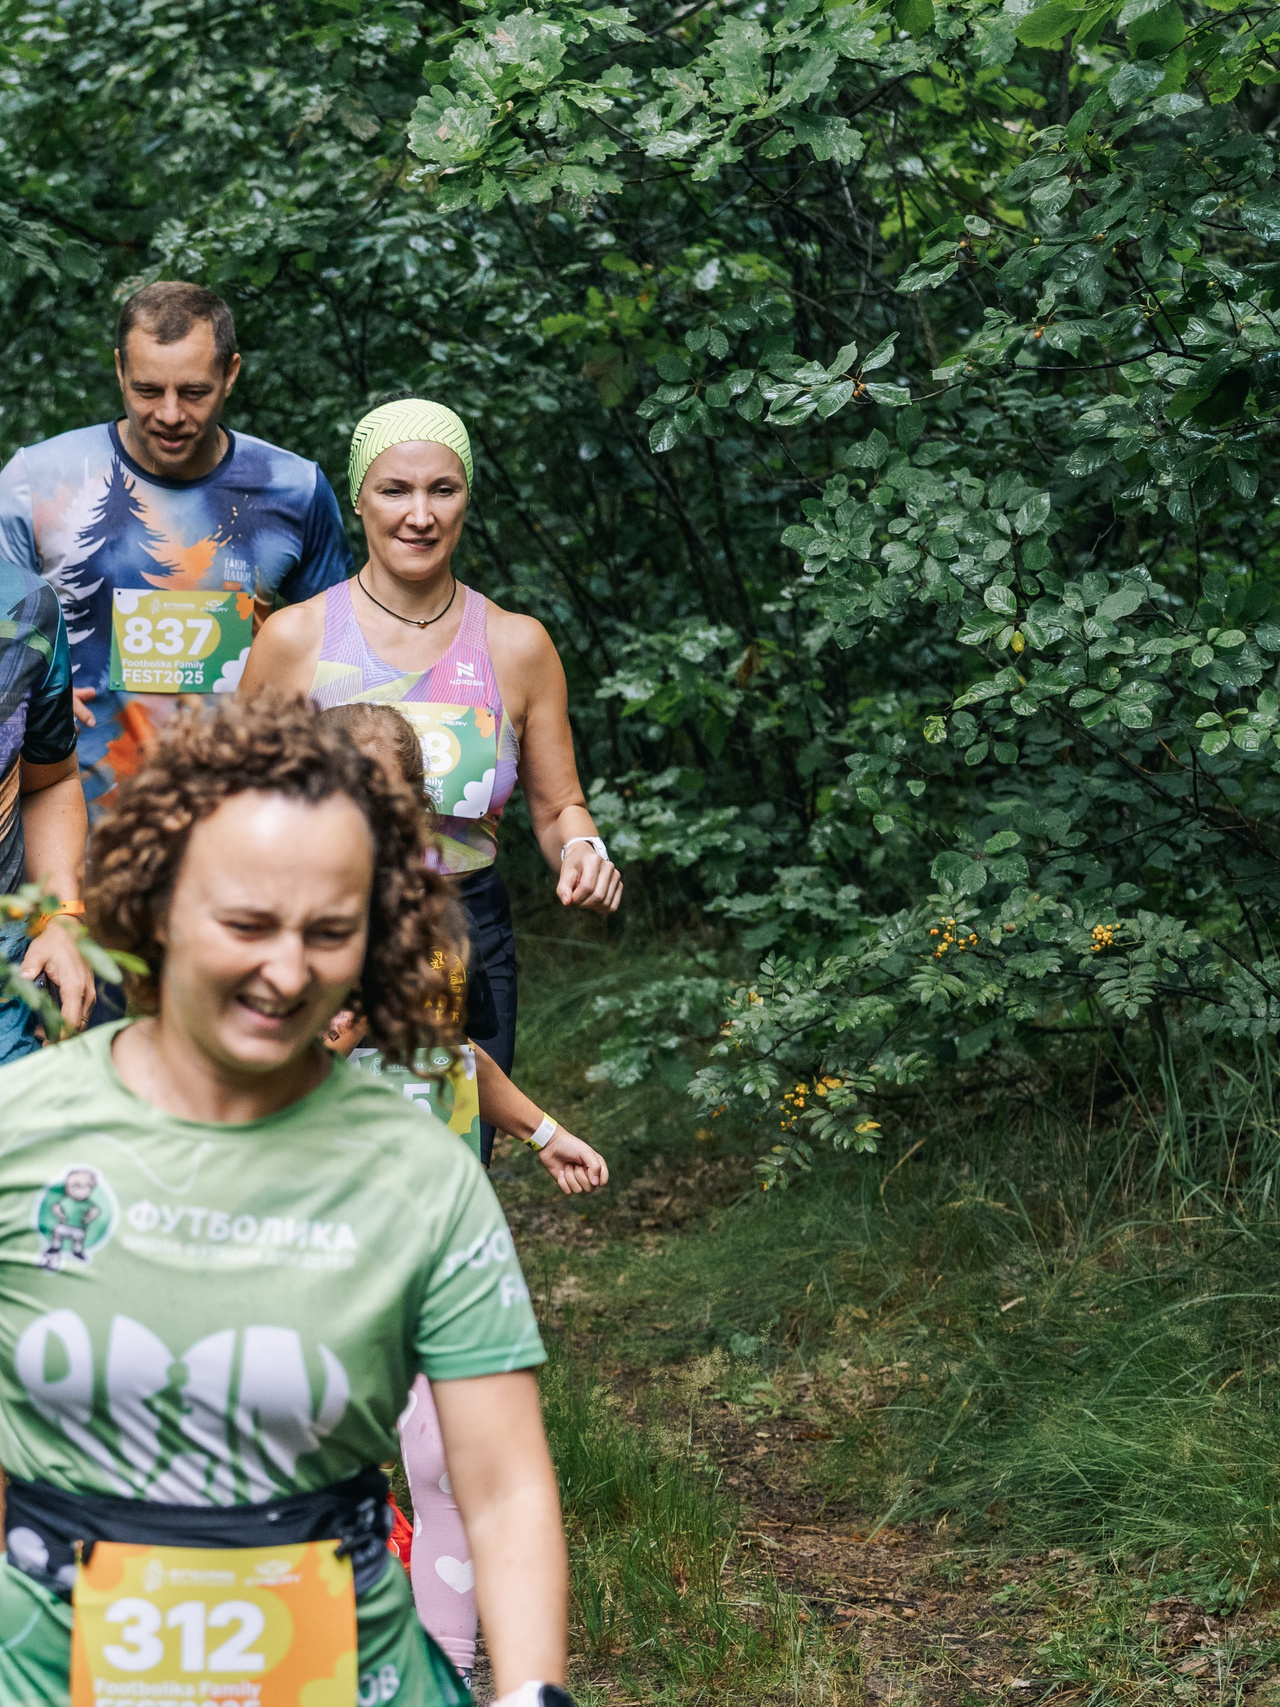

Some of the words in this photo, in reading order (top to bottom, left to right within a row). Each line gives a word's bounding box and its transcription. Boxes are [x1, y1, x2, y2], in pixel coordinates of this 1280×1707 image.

[122, 616, 214, 656] 837
[122, 658, 172, 668] Footbolika
[174, 660, 204, 670] Family
[122, 669, 204, 684] FEST2025
[125, 1199, 358, 1252] ФУТБОЛИКА
[102, 1597, 266, 1673] 312
[94, 1678, 196, 1698] Footbolika
[199, 1680, 263, 1700] Family
